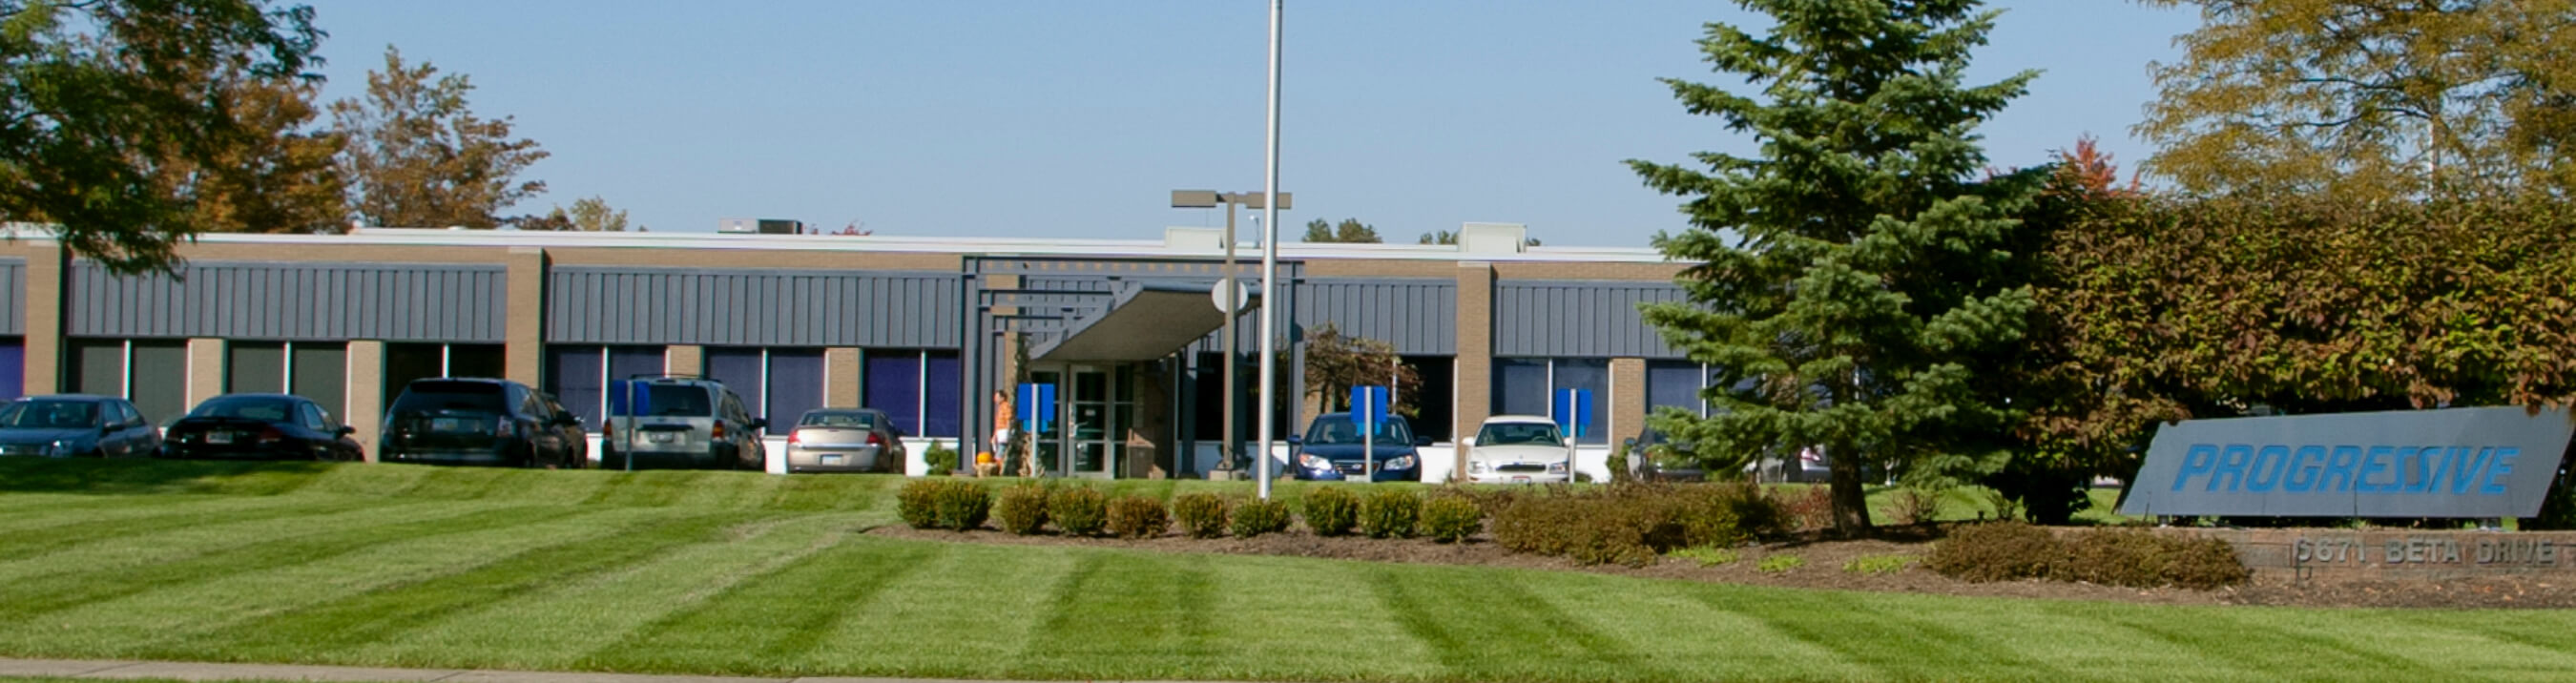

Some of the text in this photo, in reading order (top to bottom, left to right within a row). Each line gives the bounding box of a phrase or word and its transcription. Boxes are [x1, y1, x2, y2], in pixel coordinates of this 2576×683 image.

[2171, 443, 2521, 494] PROGRESSIVE
[2385, 538, 2462, 564] BETA
[2477, 539, 2555, 565] DRIVE
